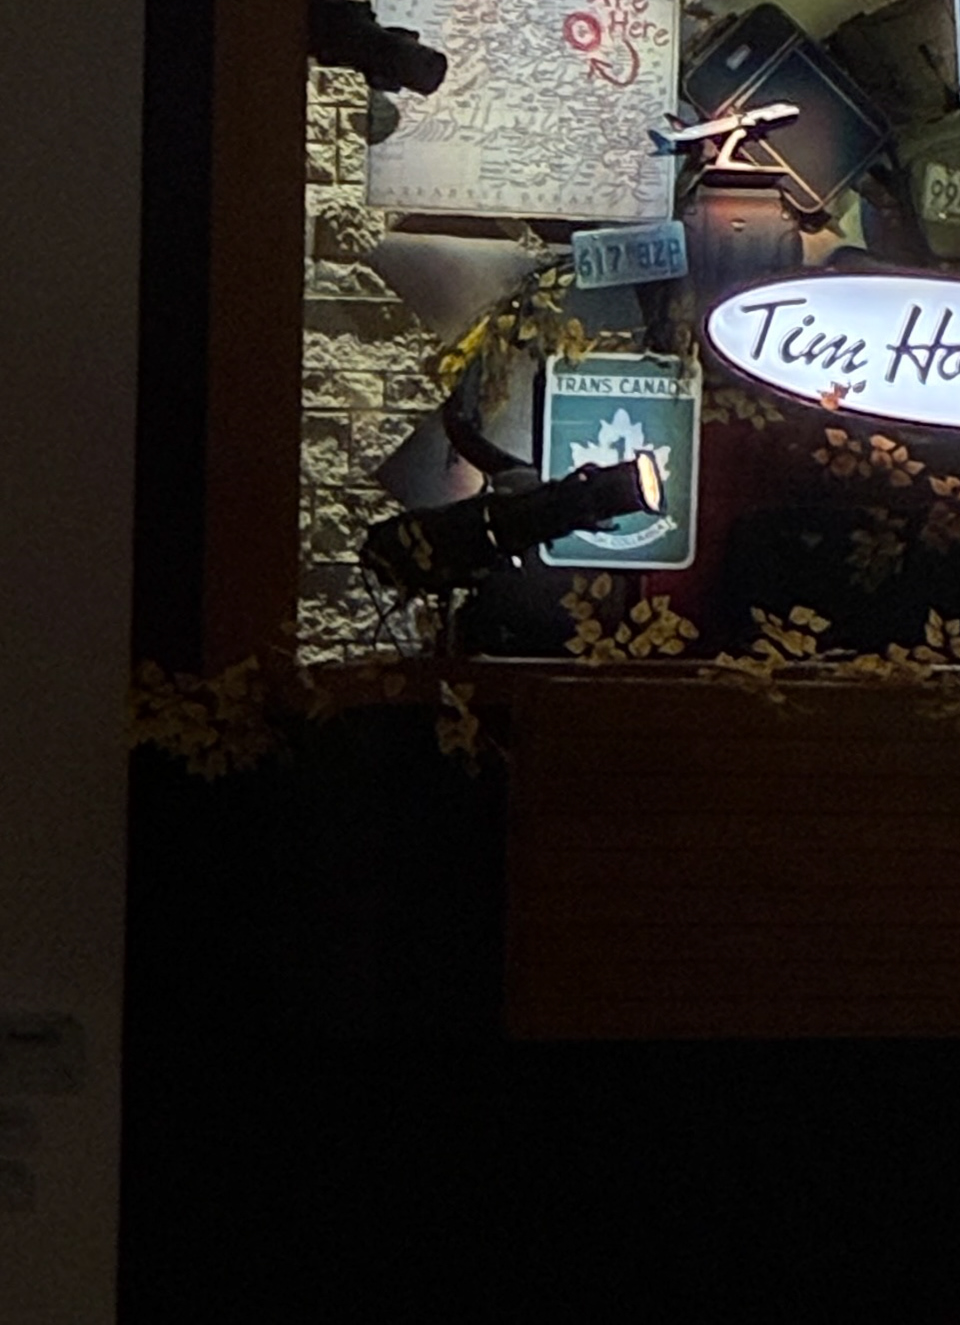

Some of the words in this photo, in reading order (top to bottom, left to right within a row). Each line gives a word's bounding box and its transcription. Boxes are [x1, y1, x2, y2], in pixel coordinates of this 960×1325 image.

[608, 10, 670, 47] Here
[741, 298, 867, 373] Tim
[556, 376, 613, 394] TRANS
[619, 378, 691, 395] CANAD
